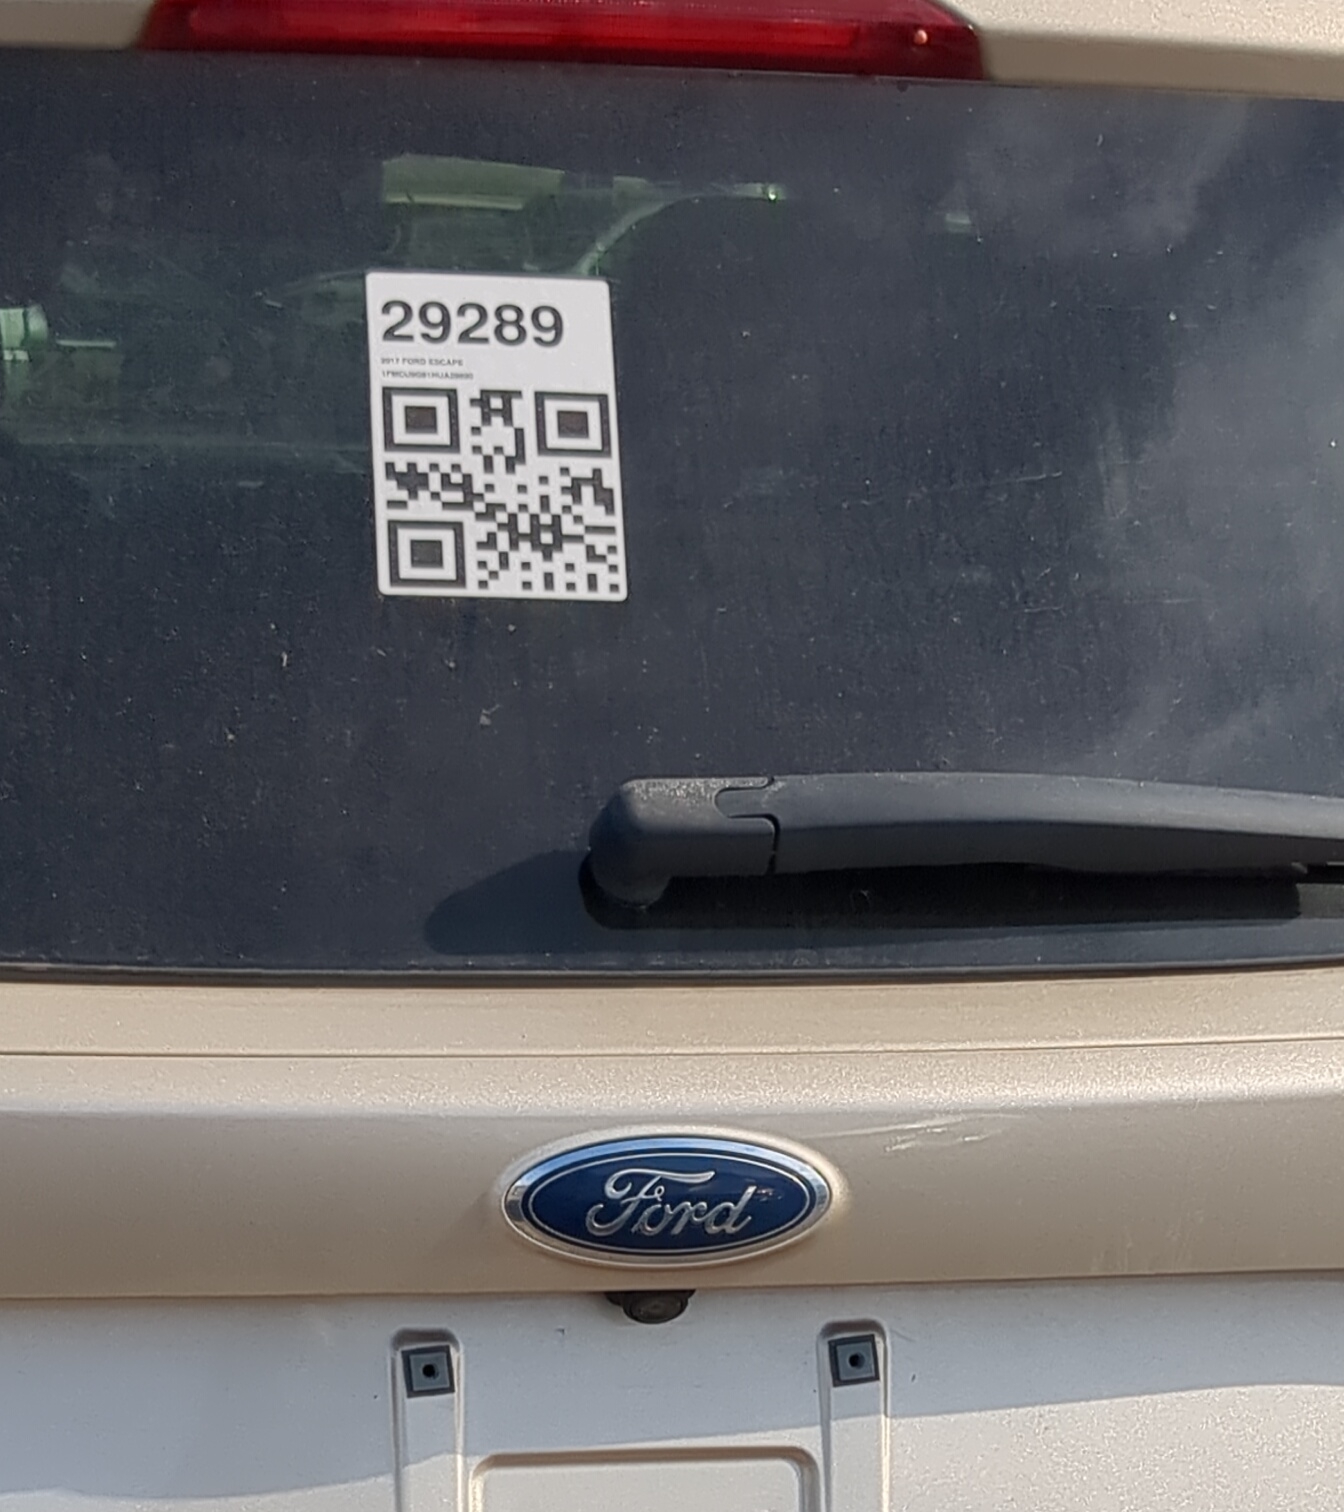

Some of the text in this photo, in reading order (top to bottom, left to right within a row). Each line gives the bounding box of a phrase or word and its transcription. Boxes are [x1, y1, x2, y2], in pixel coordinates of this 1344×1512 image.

[380, 299, 565, 348] 29289
[402, 358, 426, 366] FORD
[429, 359, 464, 367] ESCAPE
[584, 1167, 757, 1238] Ford
